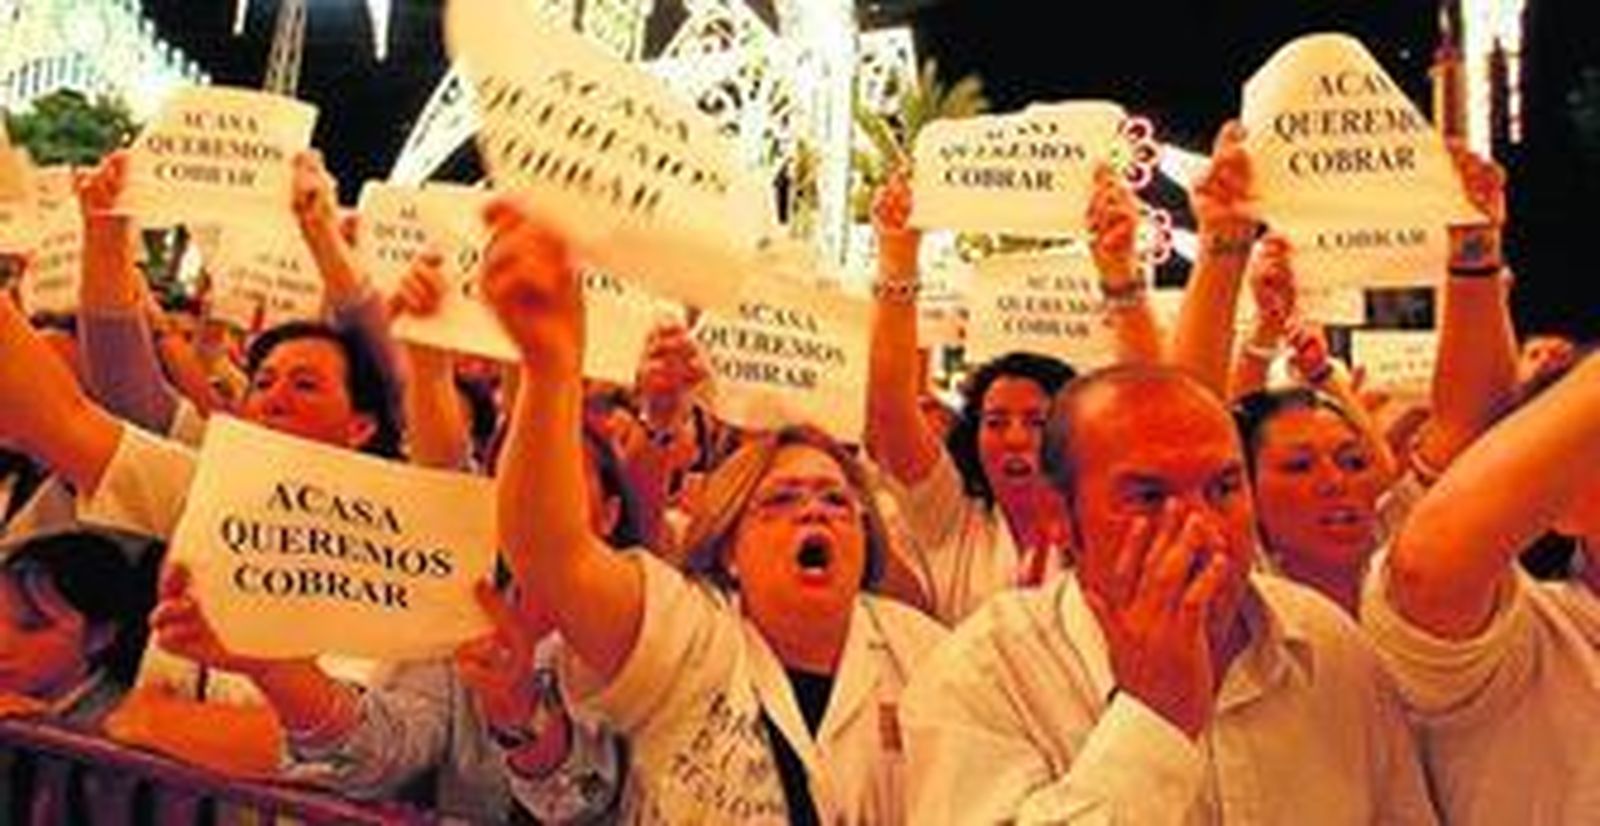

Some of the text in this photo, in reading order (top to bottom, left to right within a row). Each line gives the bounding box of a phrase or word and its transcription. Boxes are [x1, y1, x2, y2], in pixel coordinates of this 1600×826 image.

[943, 169, 1054, 191] COBRAR
[1288, 147, 1415, 177] COBRAR
[265, 481, 402, 535] ACASA
[220, 515, 455, 578] QUEREMOS
[232, 563, 410, 609] COBRAR
